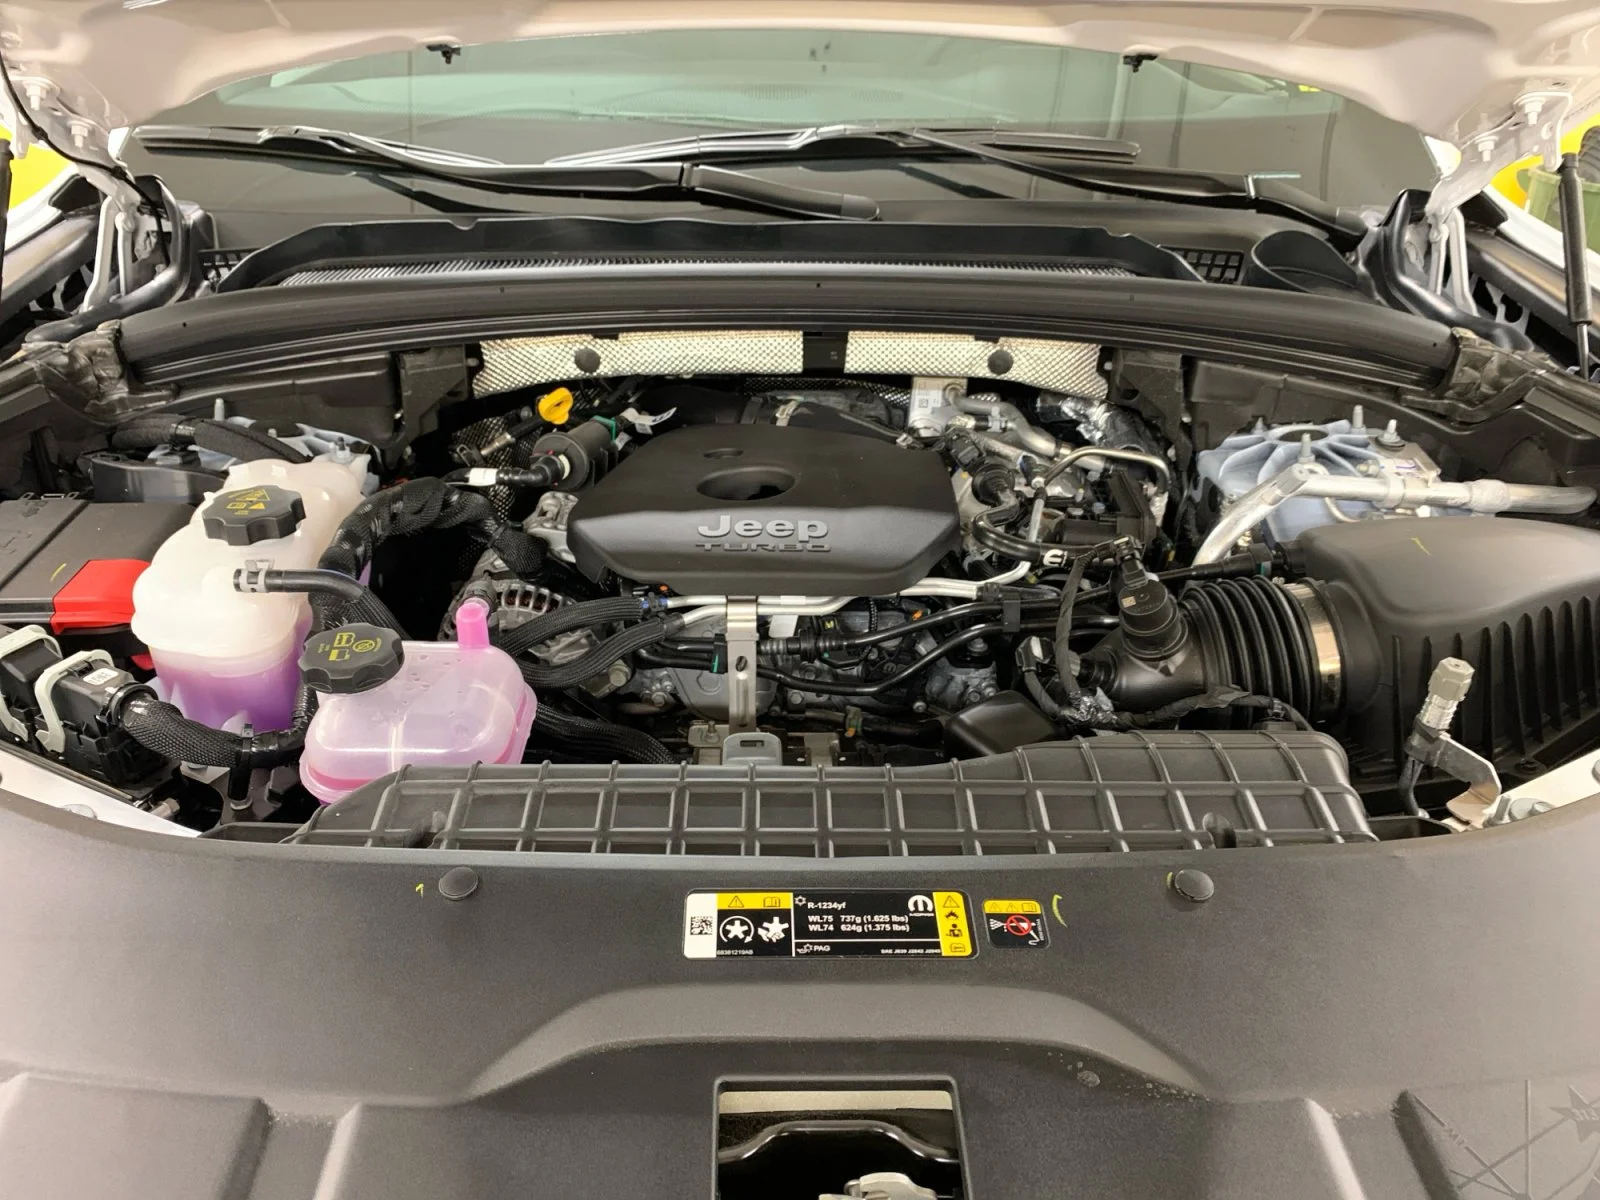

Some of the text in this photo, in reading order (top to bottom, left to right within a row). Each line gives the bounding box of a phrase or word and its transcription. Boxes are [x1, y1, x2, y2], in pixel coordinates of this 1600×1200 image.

[698, 514, 828, 543] Jeep
[696, 542, 831, 552] TURBO
[807, 902, 846, 910] R-1234yf
[808, 914, 909, 924] WL75 737g (1.625 lbs)
[808, 923, 910, 933] WL74 624g (1.375 lbs)
